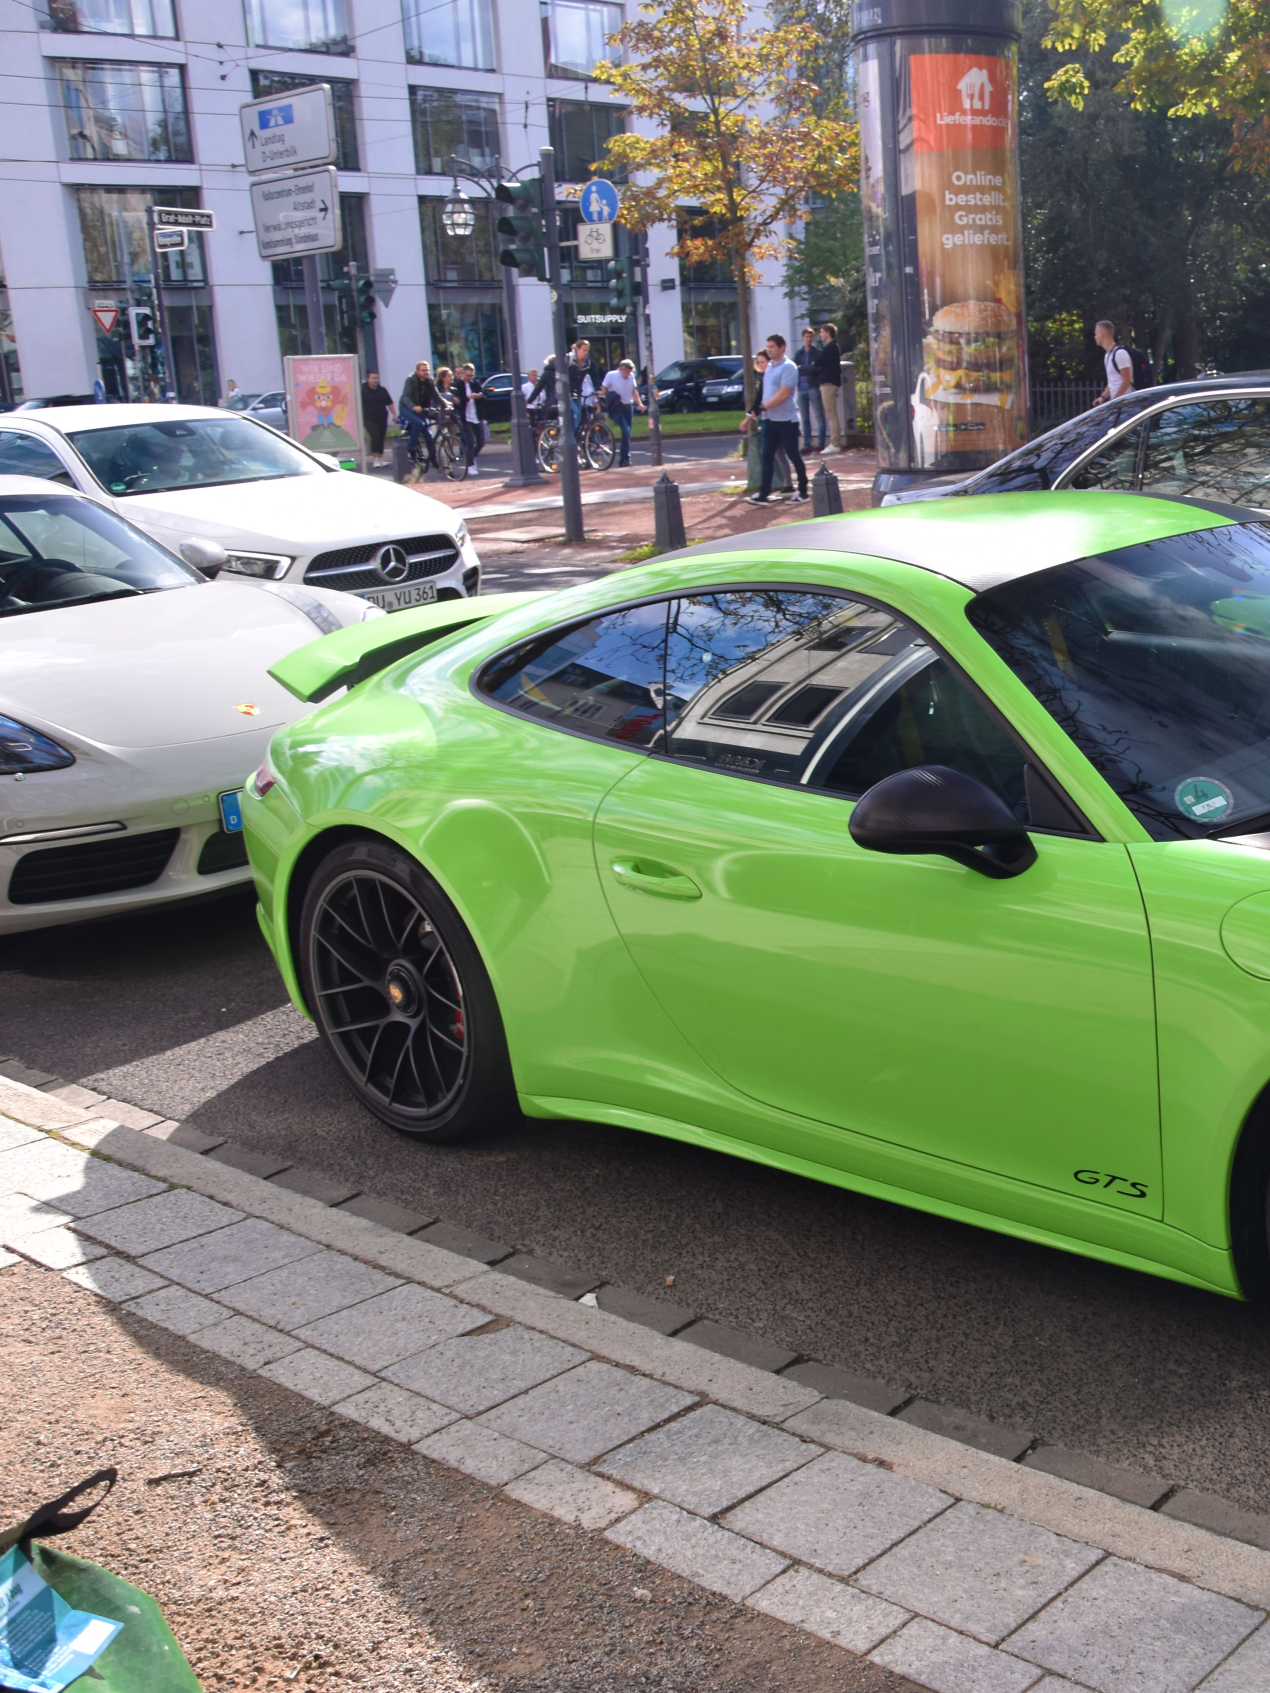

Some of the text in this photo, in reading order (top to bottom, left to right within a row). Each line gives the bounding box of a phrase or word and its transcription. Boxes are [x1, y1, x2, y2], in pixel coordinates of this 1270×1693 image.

[936, 112, 1009, 128] Lieferando.de
[261, 133, 286, 147] Landtag
[262, 145, 298, 163] D-Unterbilk
[951, 171, 1004, 187] Online
[944, 190, 1008, 206] bestellt.
[954, 210, 1003, 226] Gratis
[942, 230, 1011, 249] geliefert.
[576, 315, 627, 323] SUITSUPPLY
[301, 364, 343, 373] WIR SIND
[297, 373, 331, 383] WIEDER
[394, 589, 412, 607] YU
[414, 584, 436, 603] 361
[1193, 784, 1209, 799] 4
[230, 815, 238, 824] D
[1074, 1169, 1149, 1198] GTS
